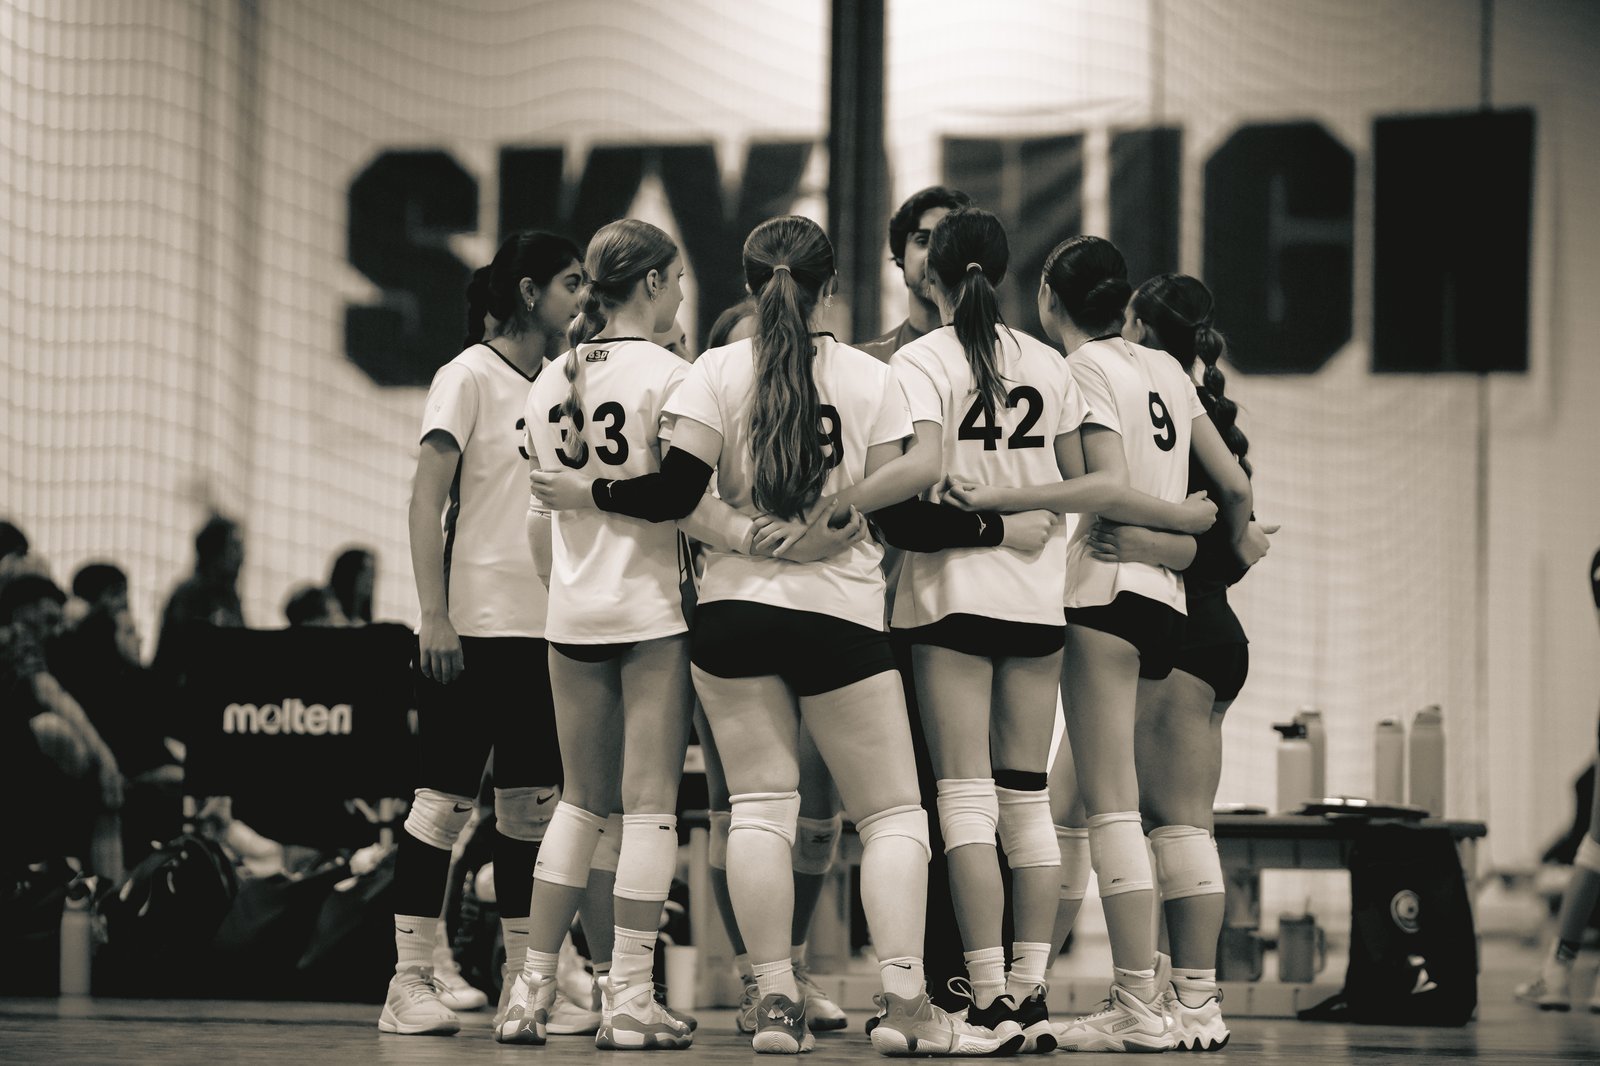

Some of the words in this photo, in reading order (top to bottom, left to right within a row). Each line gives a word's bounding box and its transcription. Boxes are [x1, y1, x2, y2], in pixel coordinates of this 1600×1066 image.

[549, 401, 629, 469] 33
[958, 385, 1045, 450] 42
[1149, 391, 1177, 452] 9
[223, 698, 353, 735] molten
